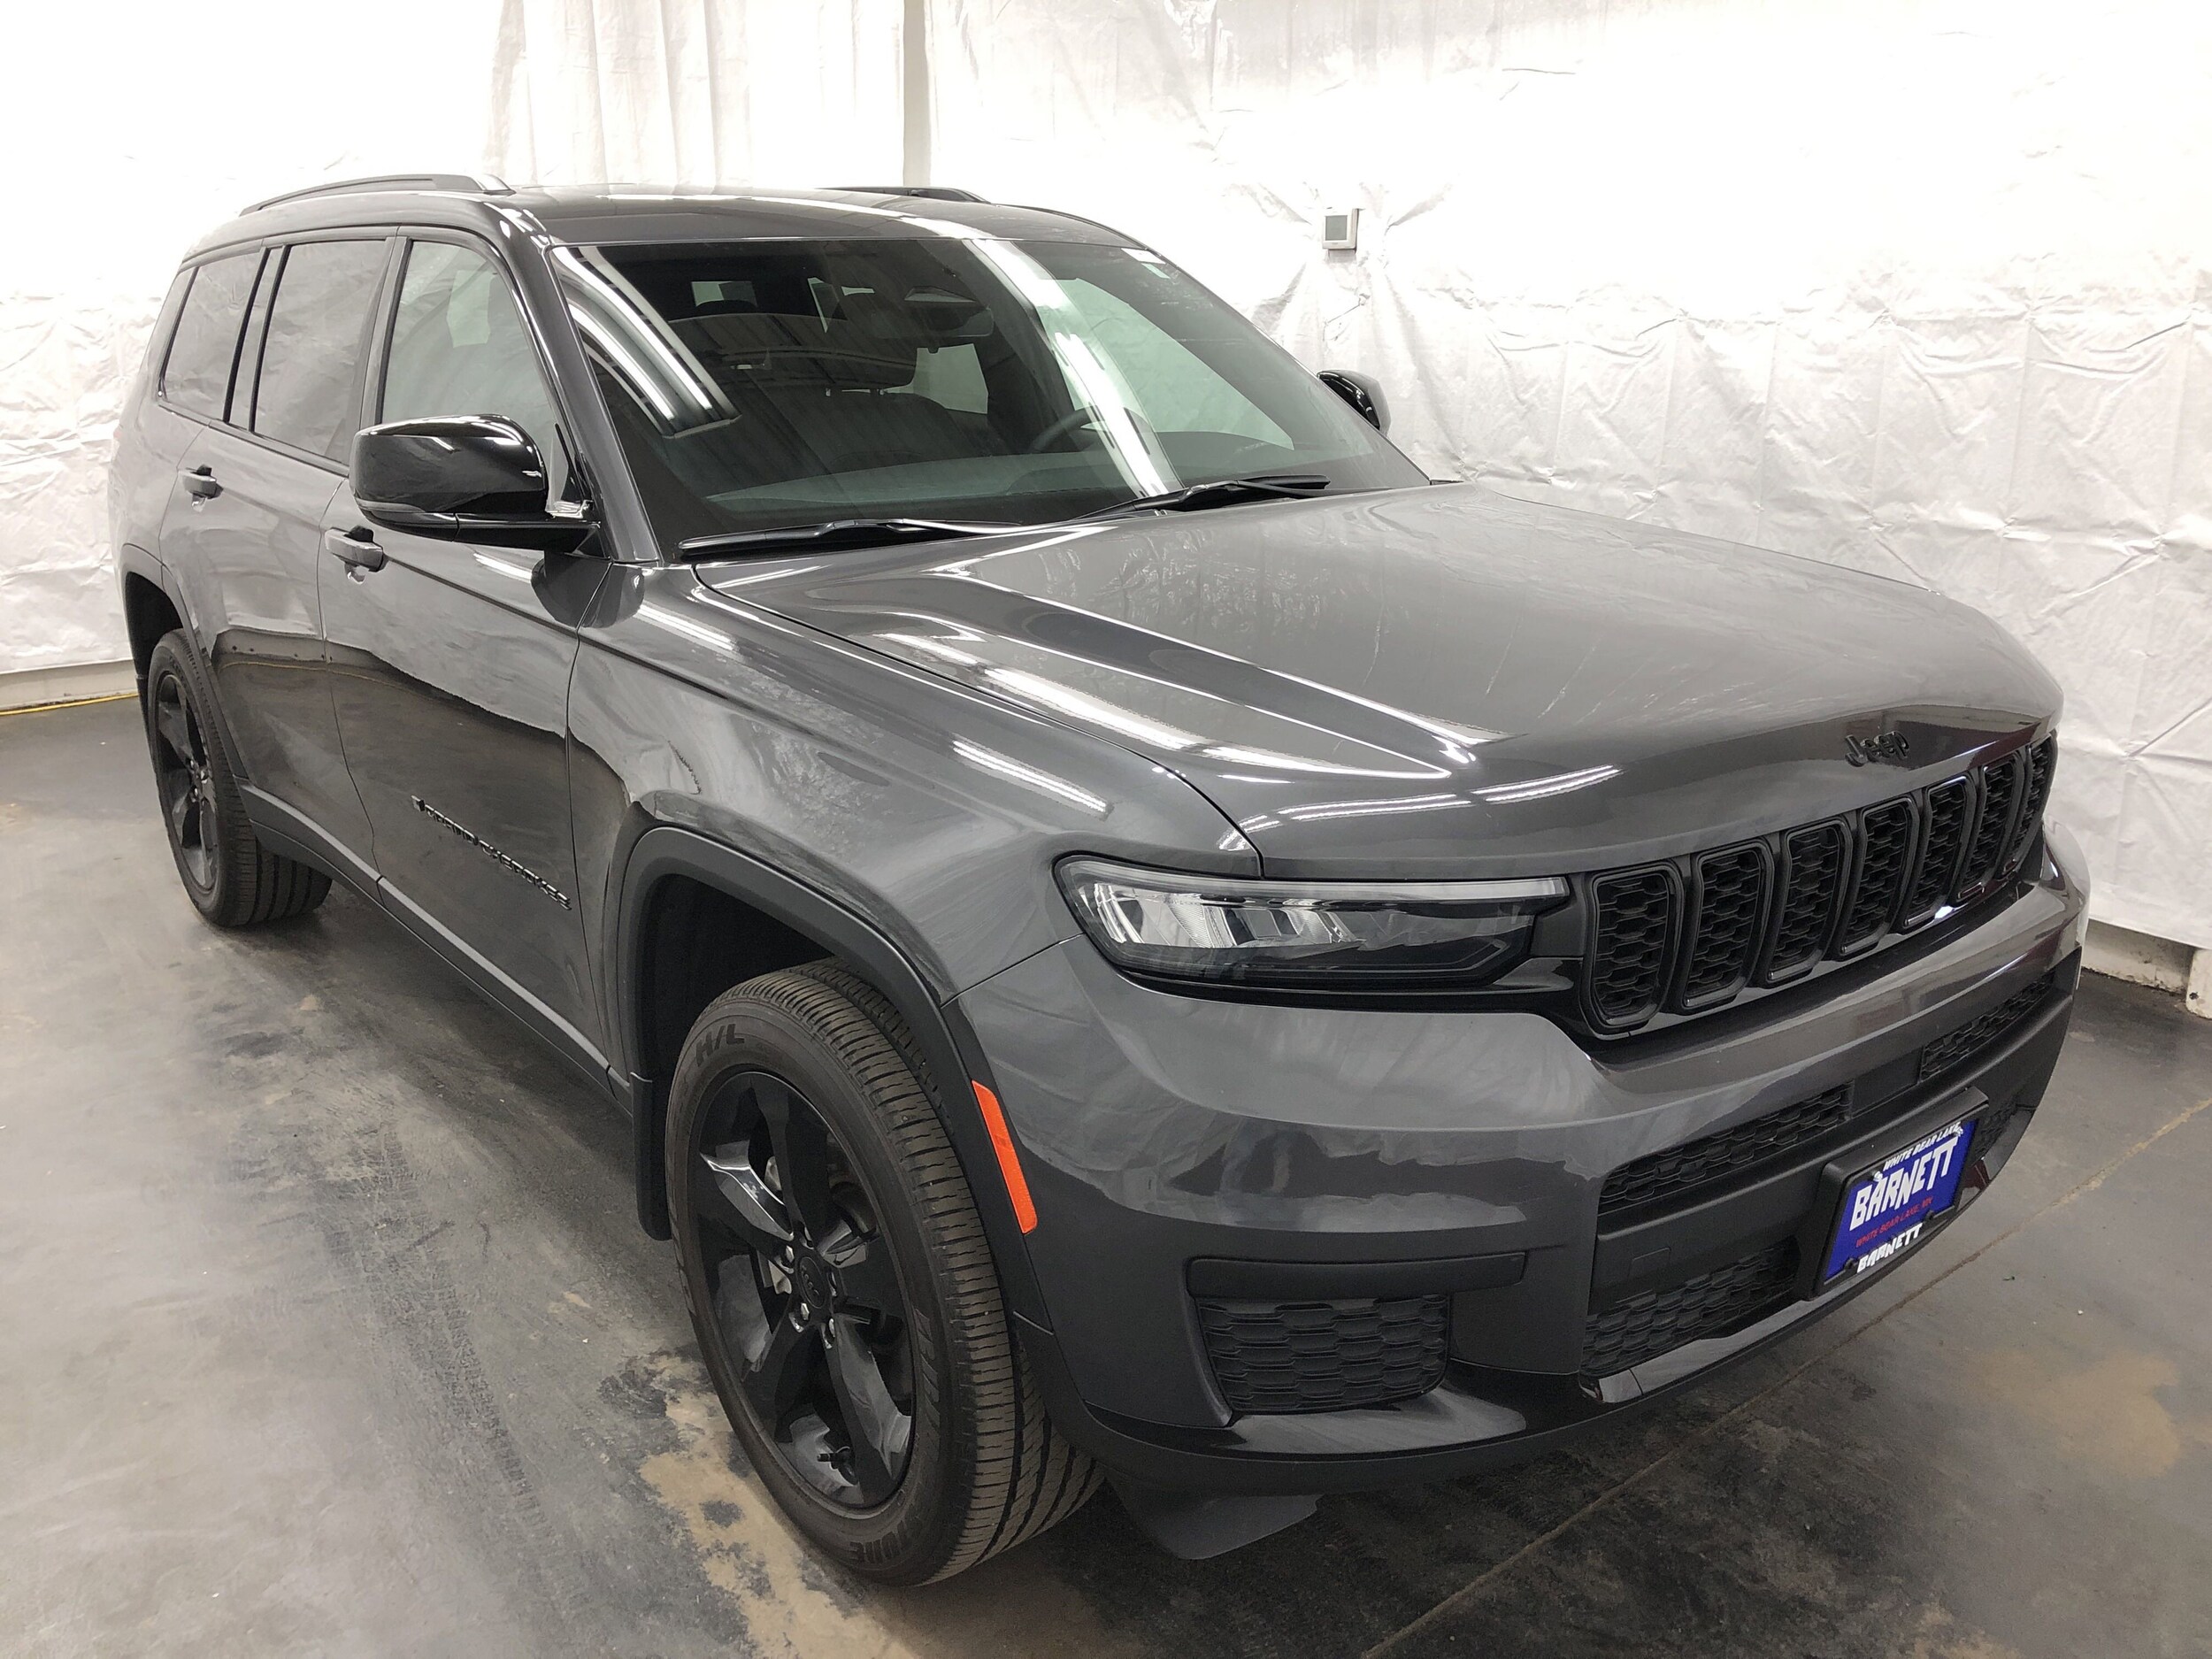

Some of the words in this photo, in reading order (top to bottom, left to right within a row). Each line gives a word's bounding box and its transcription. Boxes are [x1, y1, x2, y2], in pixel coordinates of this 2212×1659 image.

[1845, 731, 1909, 767] Jeep
[695, 1023, 745, 1068] H/L
[1884, 1148, 1913, 1171] WHITE
[1912, 1134, 1938, 1156] BEAR
[1848, 1136, 1960, 1232] BARNETT
[1855, 1229, 1878, 1248] WHITE
[1856, 1222, 1924, 1274] BARNETT
